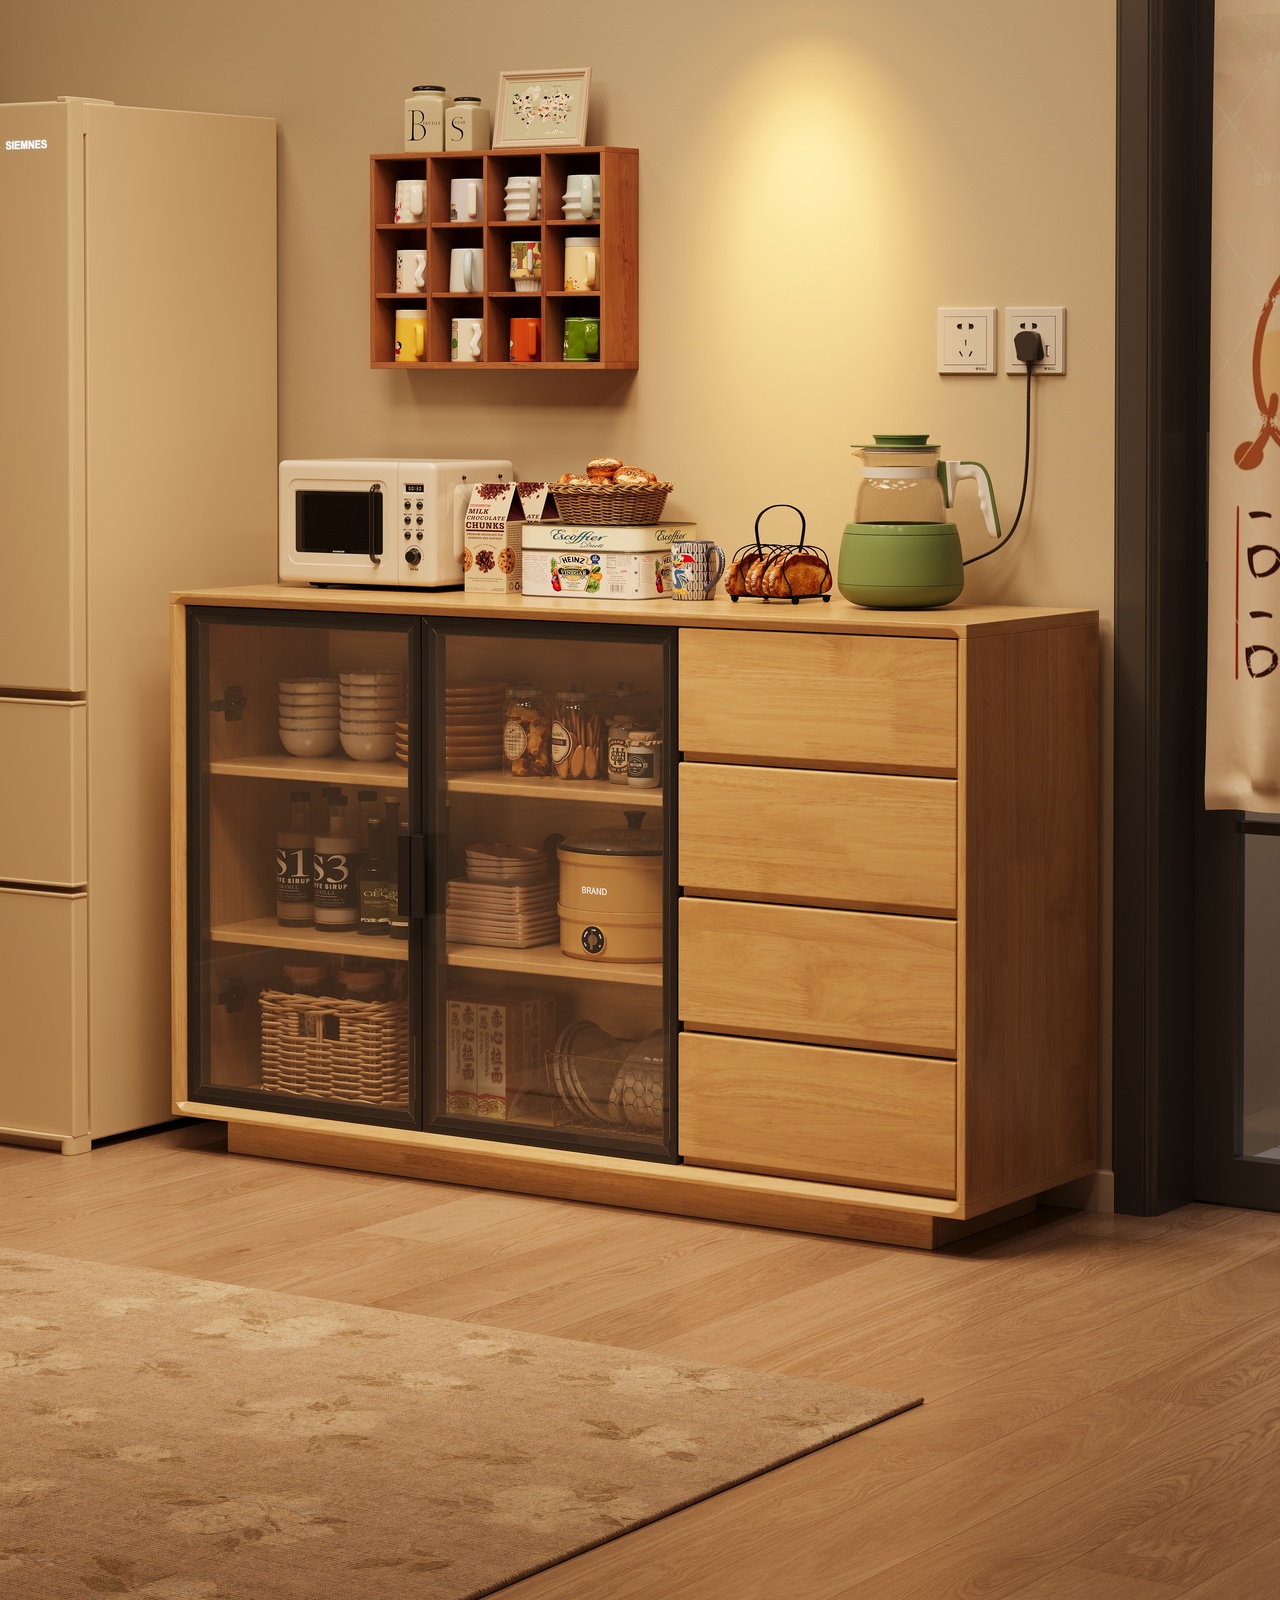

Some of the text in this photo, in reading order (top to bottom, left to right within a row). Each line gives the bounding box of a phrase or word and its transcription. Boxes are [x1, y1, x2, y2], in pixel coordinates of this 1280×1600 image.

[5, 139, 48, 150] SIEMNES
[465, 521, 505, 529] CHUNKS
[550, 528, 608, 544] Escoffier
[655, 529, 687, 544] Escoffier
[561, 556, 586, 565] HEINZ
[313, 854, 349, 884] S3
[581, 886, 608, 896] BRAND
